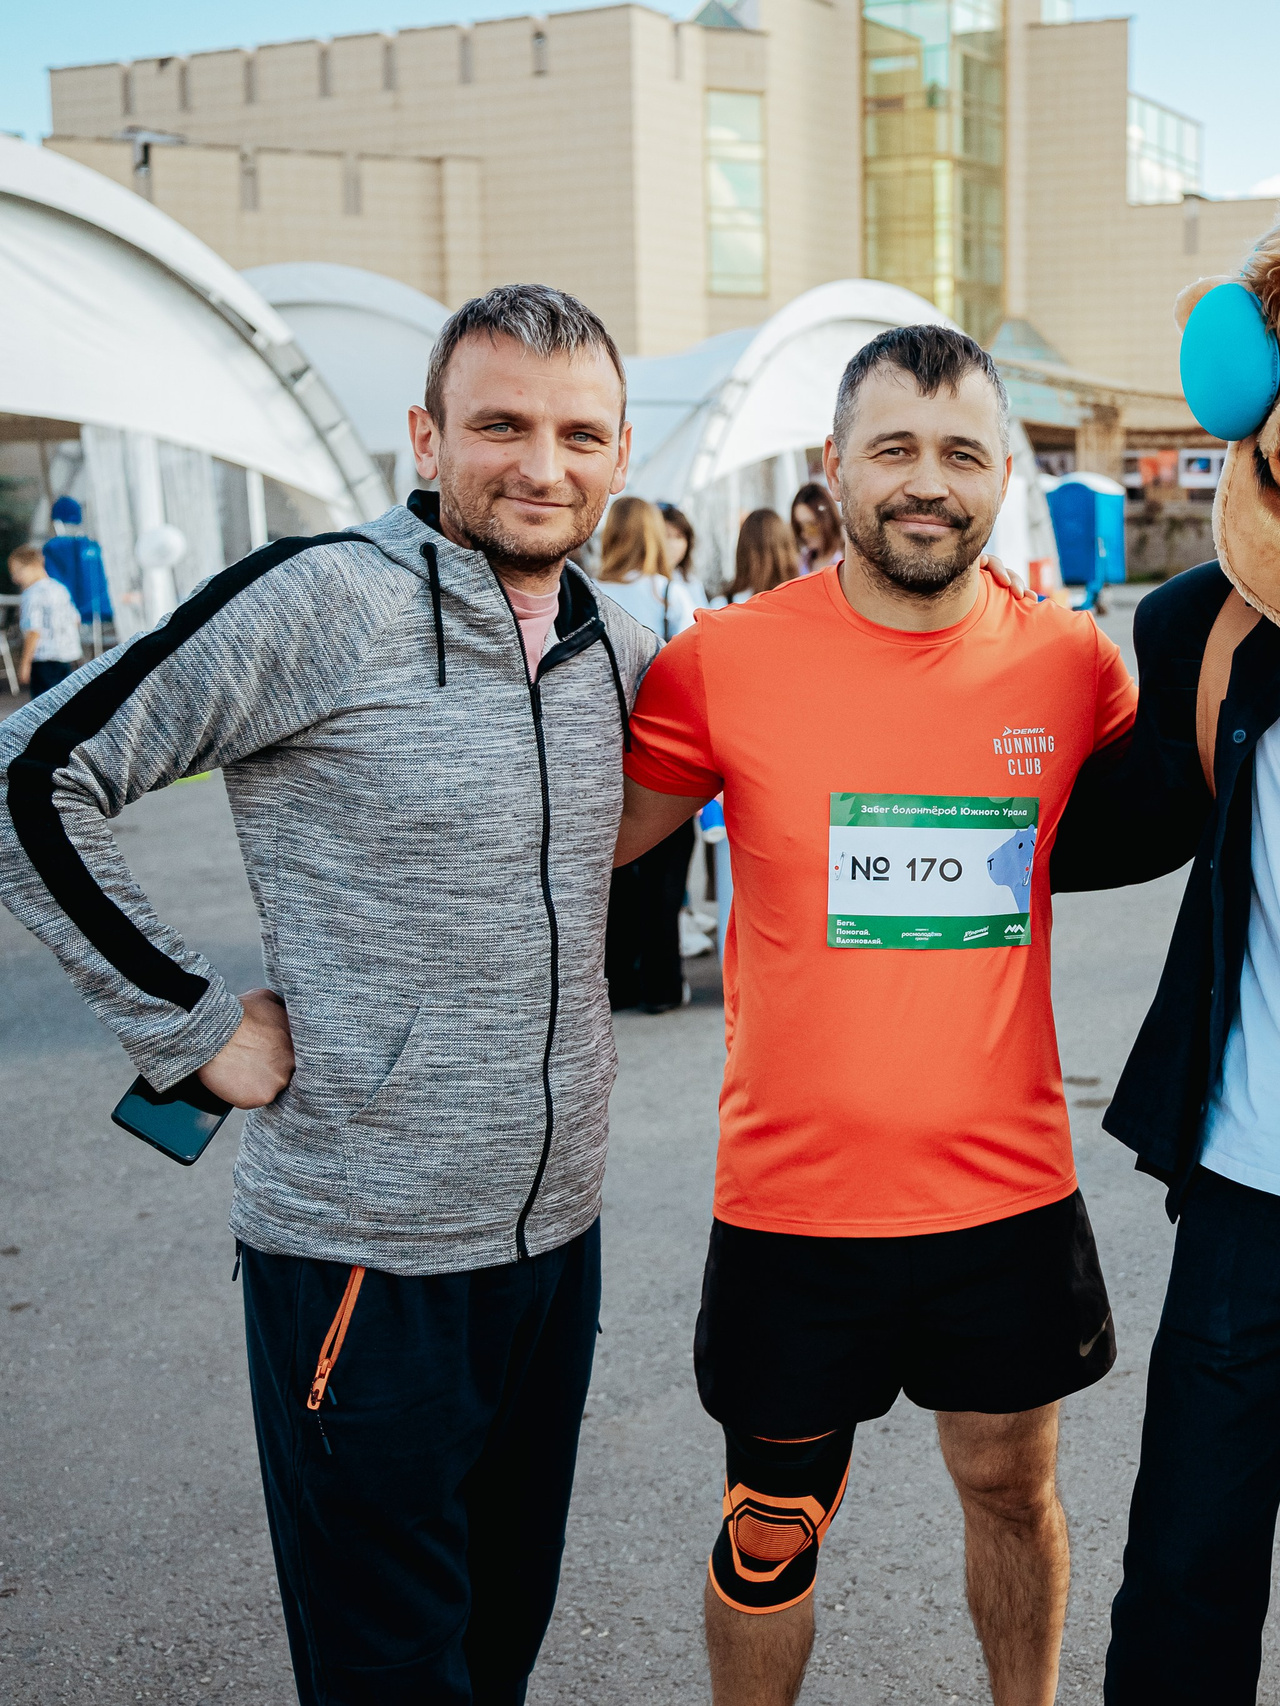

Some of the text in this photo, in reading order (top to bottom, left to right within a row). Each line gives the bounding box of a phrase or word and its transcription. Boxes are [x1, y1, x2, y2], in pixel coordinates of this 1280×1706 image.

[1012, 727, 1046, 735] DEMIX
[993, 735, 1055, 755] RUNNING
[1007, 757, 1042, 776] CLUB
[860, 804, 1028, 817] Забег волонтёров Южного Урала
[851, 855, 963, 882] № 170
[836, 919, 856, 927] Беги.
[836, 928, 870, 936] Помогай.
[836, 937, 883, 945] Вдохновляй.
